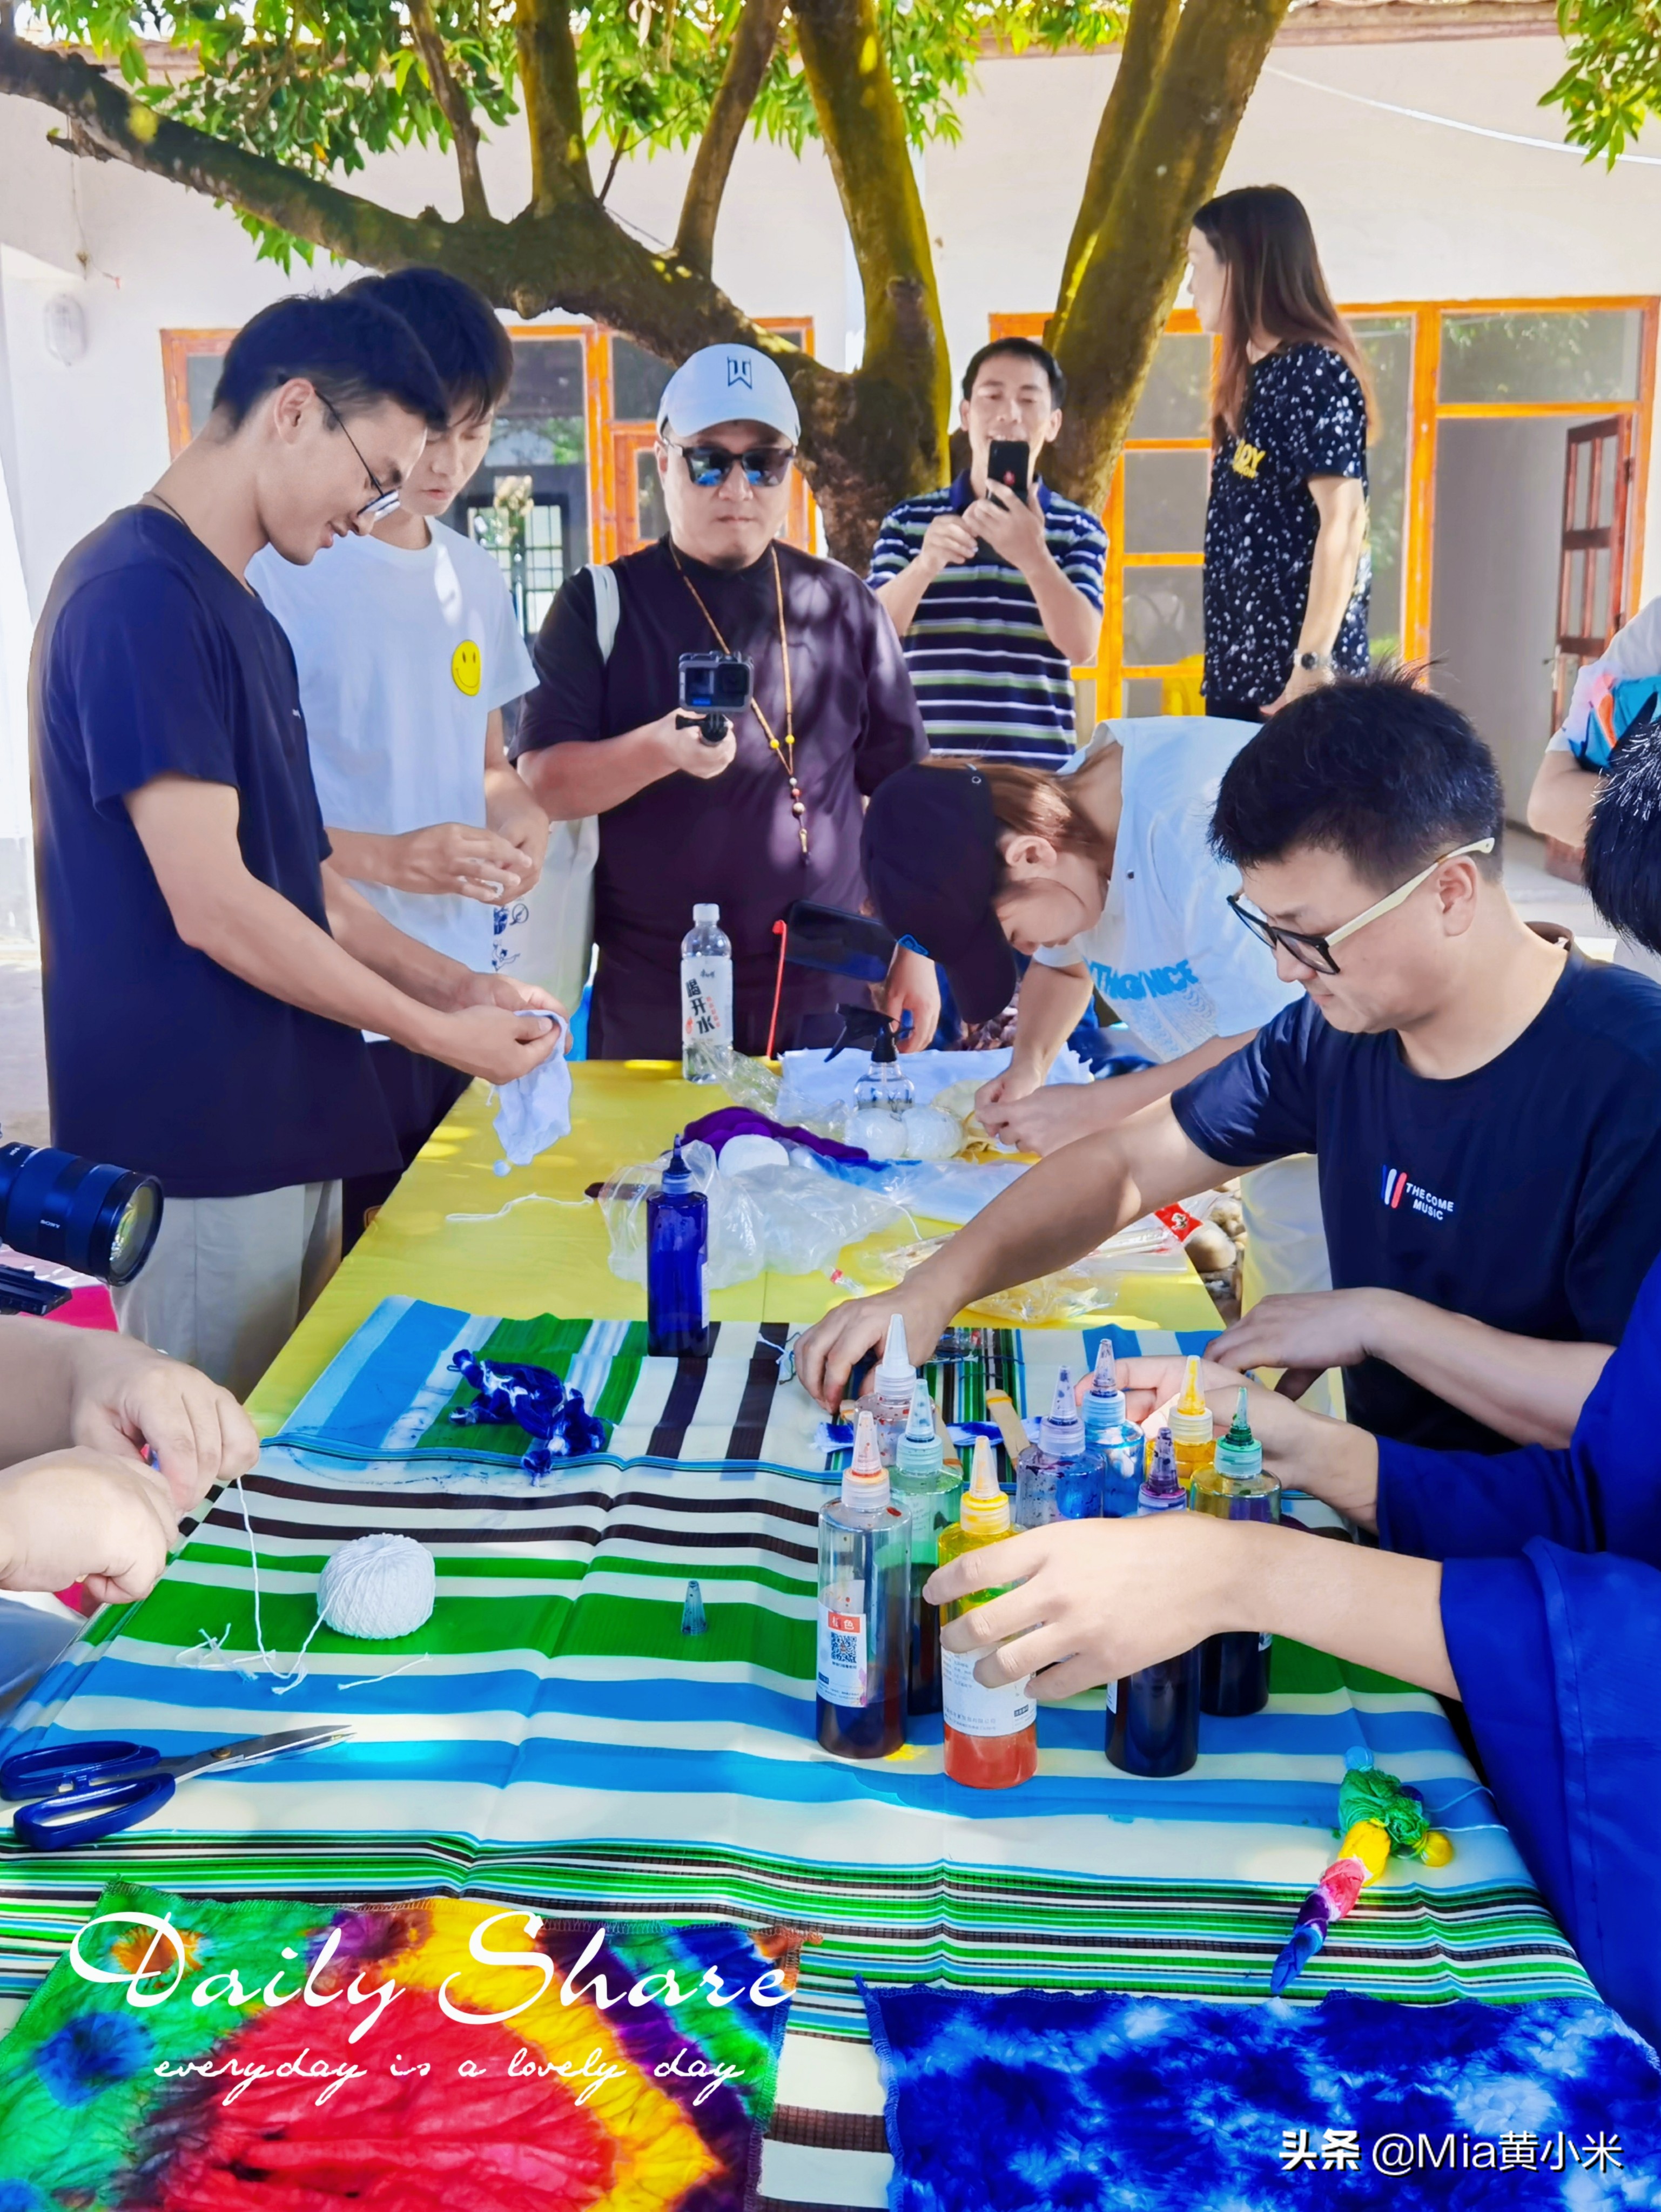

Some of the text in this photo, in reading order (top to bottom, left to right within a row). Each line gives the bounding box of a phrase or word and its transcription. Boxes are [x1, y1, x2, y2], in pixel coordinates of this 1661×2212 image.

[685, 978, 716, 1034] 喝开水
[1413, 1198, 1443, 1220] MUSIC
